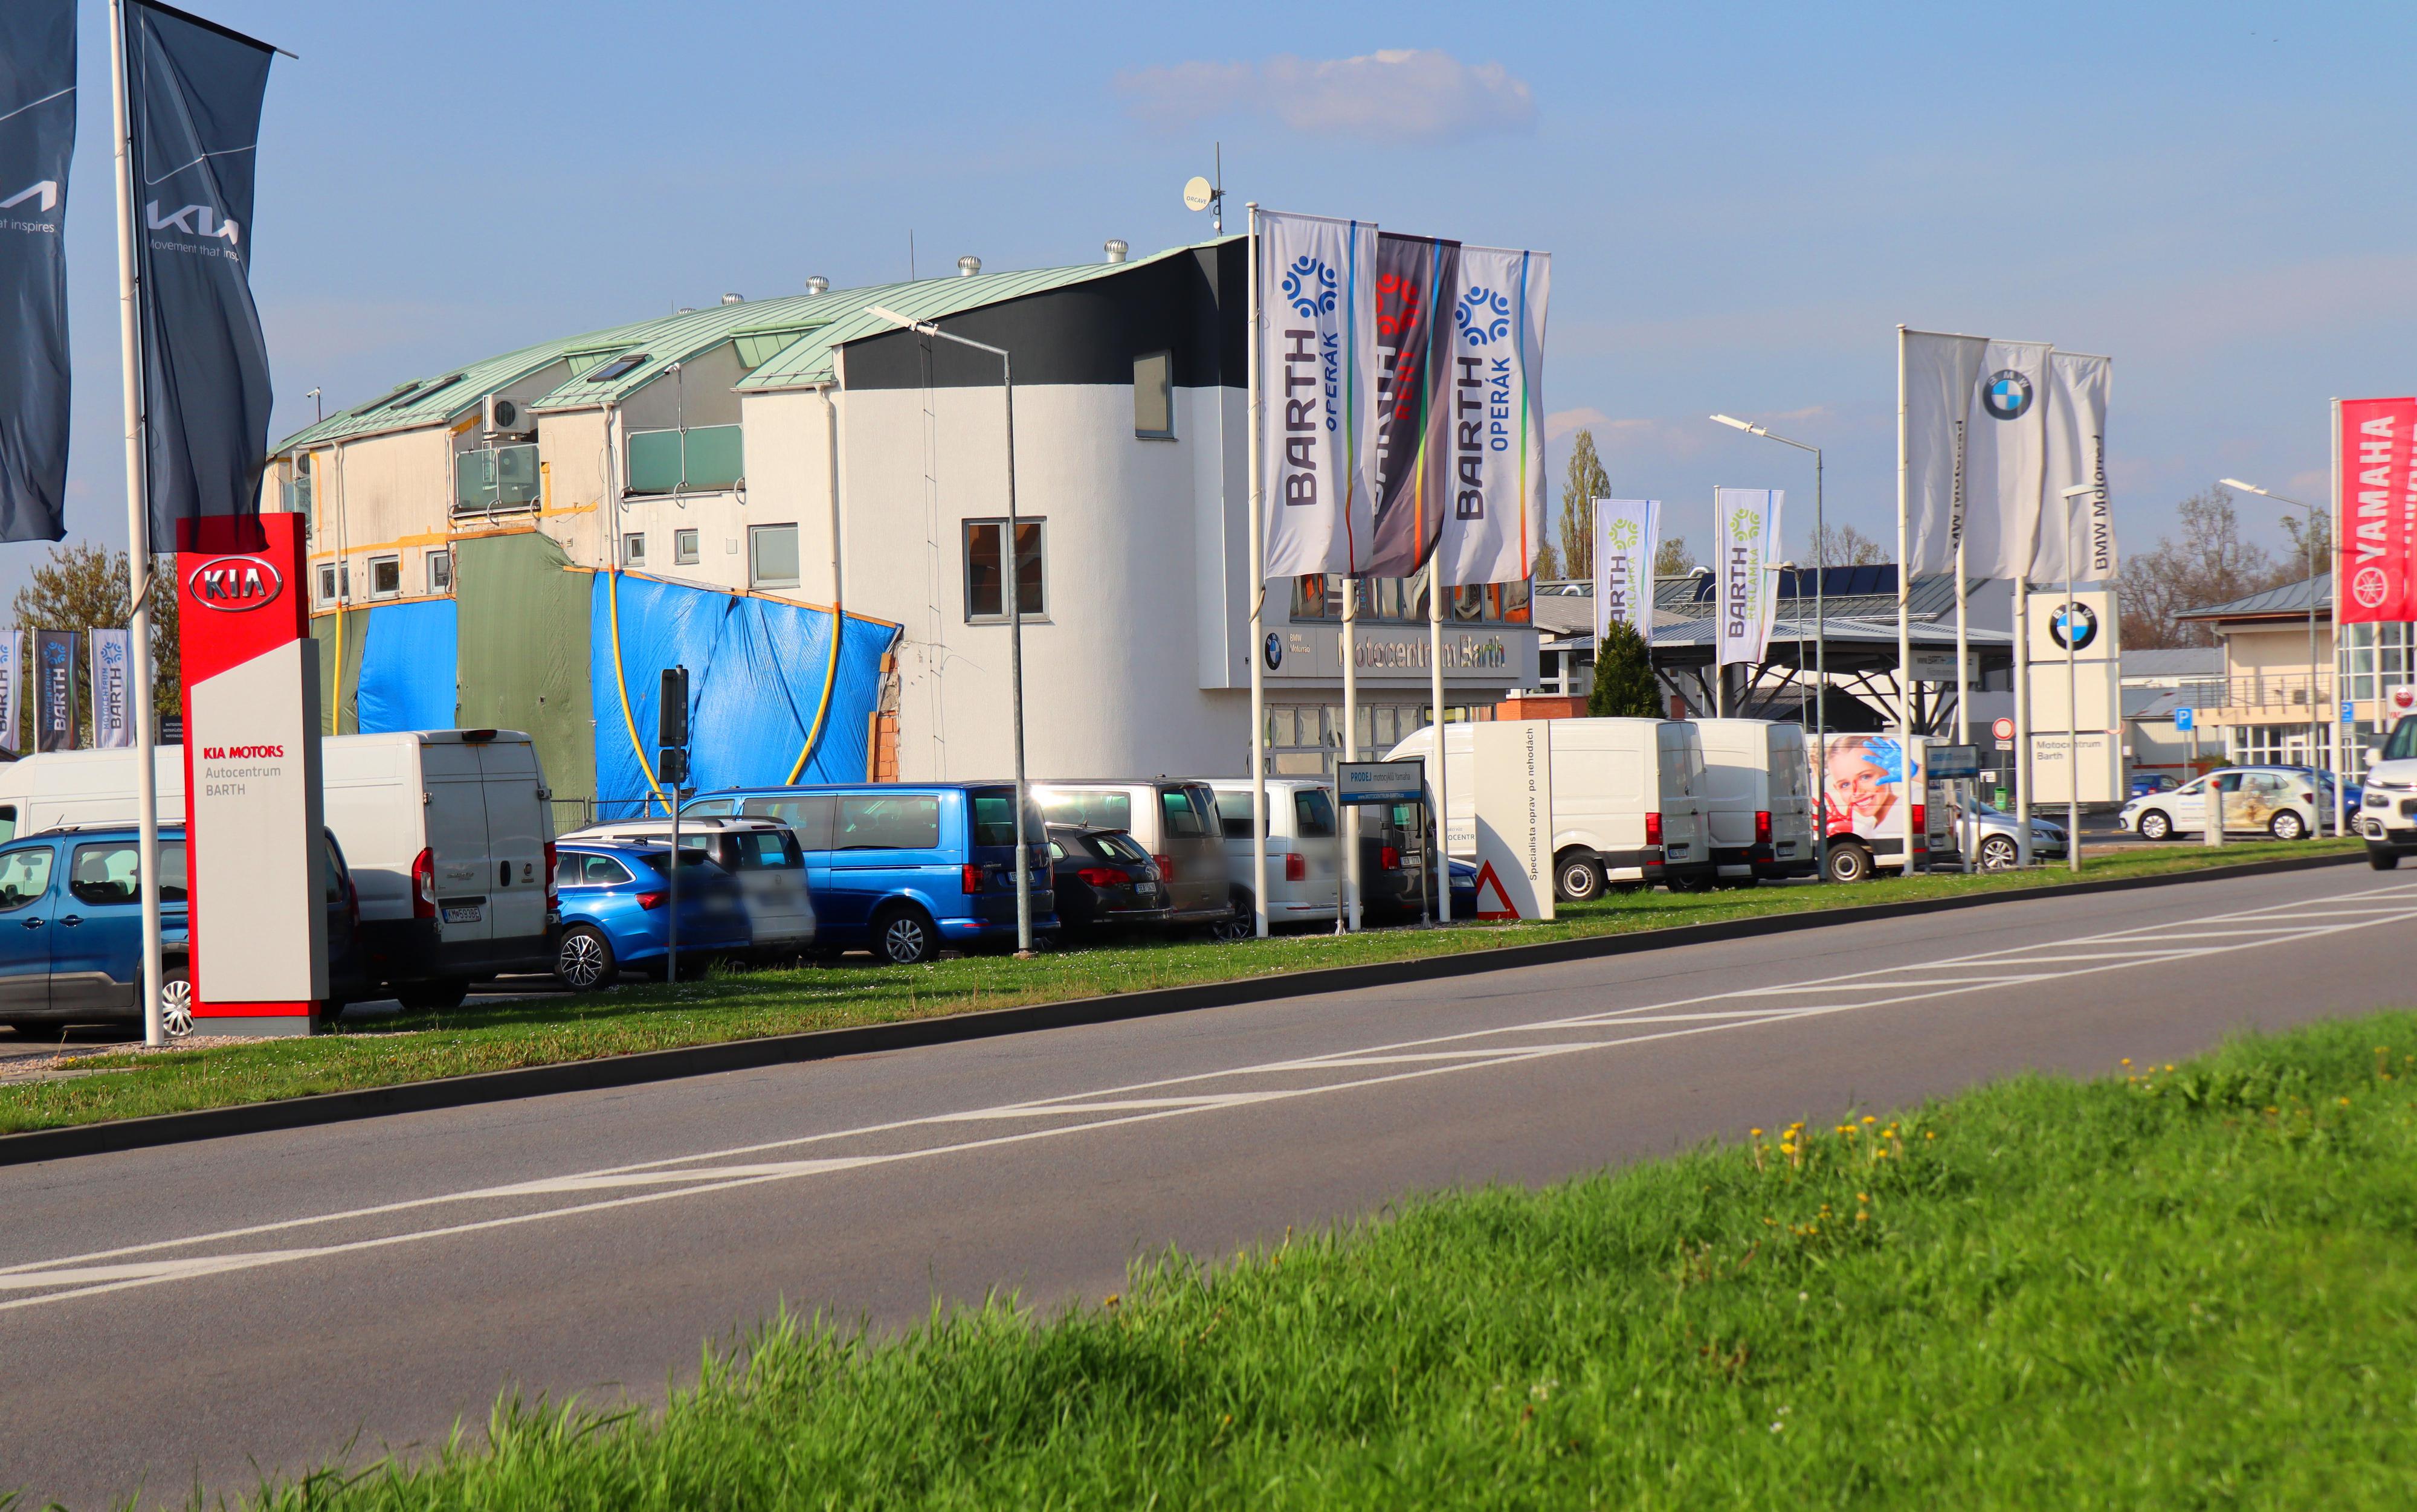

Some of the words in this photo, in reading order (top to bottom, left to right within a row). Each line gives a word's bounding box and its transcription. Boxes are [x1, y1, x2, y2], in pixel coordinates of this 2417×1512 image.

[11, 219, 55, 234] inspires
[146, 199, 239, 245] KIA
[200, 245, 221, 257] that
[1320, 332, 1338, 432] OPERÁK
[1395, 350, 1415, 420] RENT
[1485, 357, 1511, 452] OPERÁK
[1285, 329, 1317, 507] BARTH
[1456, 356, 1484, 521] BARTH
[2355, 415, 2396, 565] YAMAHA
[2093, 523, 2108, 571] BMW
[204, 568, 266, 599] KIA
[1610, 556, 1626, 627] ARTH
[1728, 547, 1747, 638] BARTH
[1746, 548, 1759, 620] REKLAMKA
[1289, 634, 1302, 642] BMW
[1289, 644, 1310, 653] Motorrad
[1337, 632, 1456, 668] otocentrm
[1459, 634, 1505, 668] Barth
[53, 668, 66, 731] BARTH
[110, 668, 122, 730] BARTH
[203, 747, 227, 759] KIA
[229, 745, 285, 759] MOTORS
[205, 766, 281, 779] Autocentrum
[1525, 727, 1535, 776] nehodách
[206, 783, 245, 796] BARTH
[1350, 772, 1372, 782] PRODEJ
[1528, 779, 1537, 791] po
[1529, 796, 1537, 825] oprav
[1528, 826, 1537, 881] Specialista
